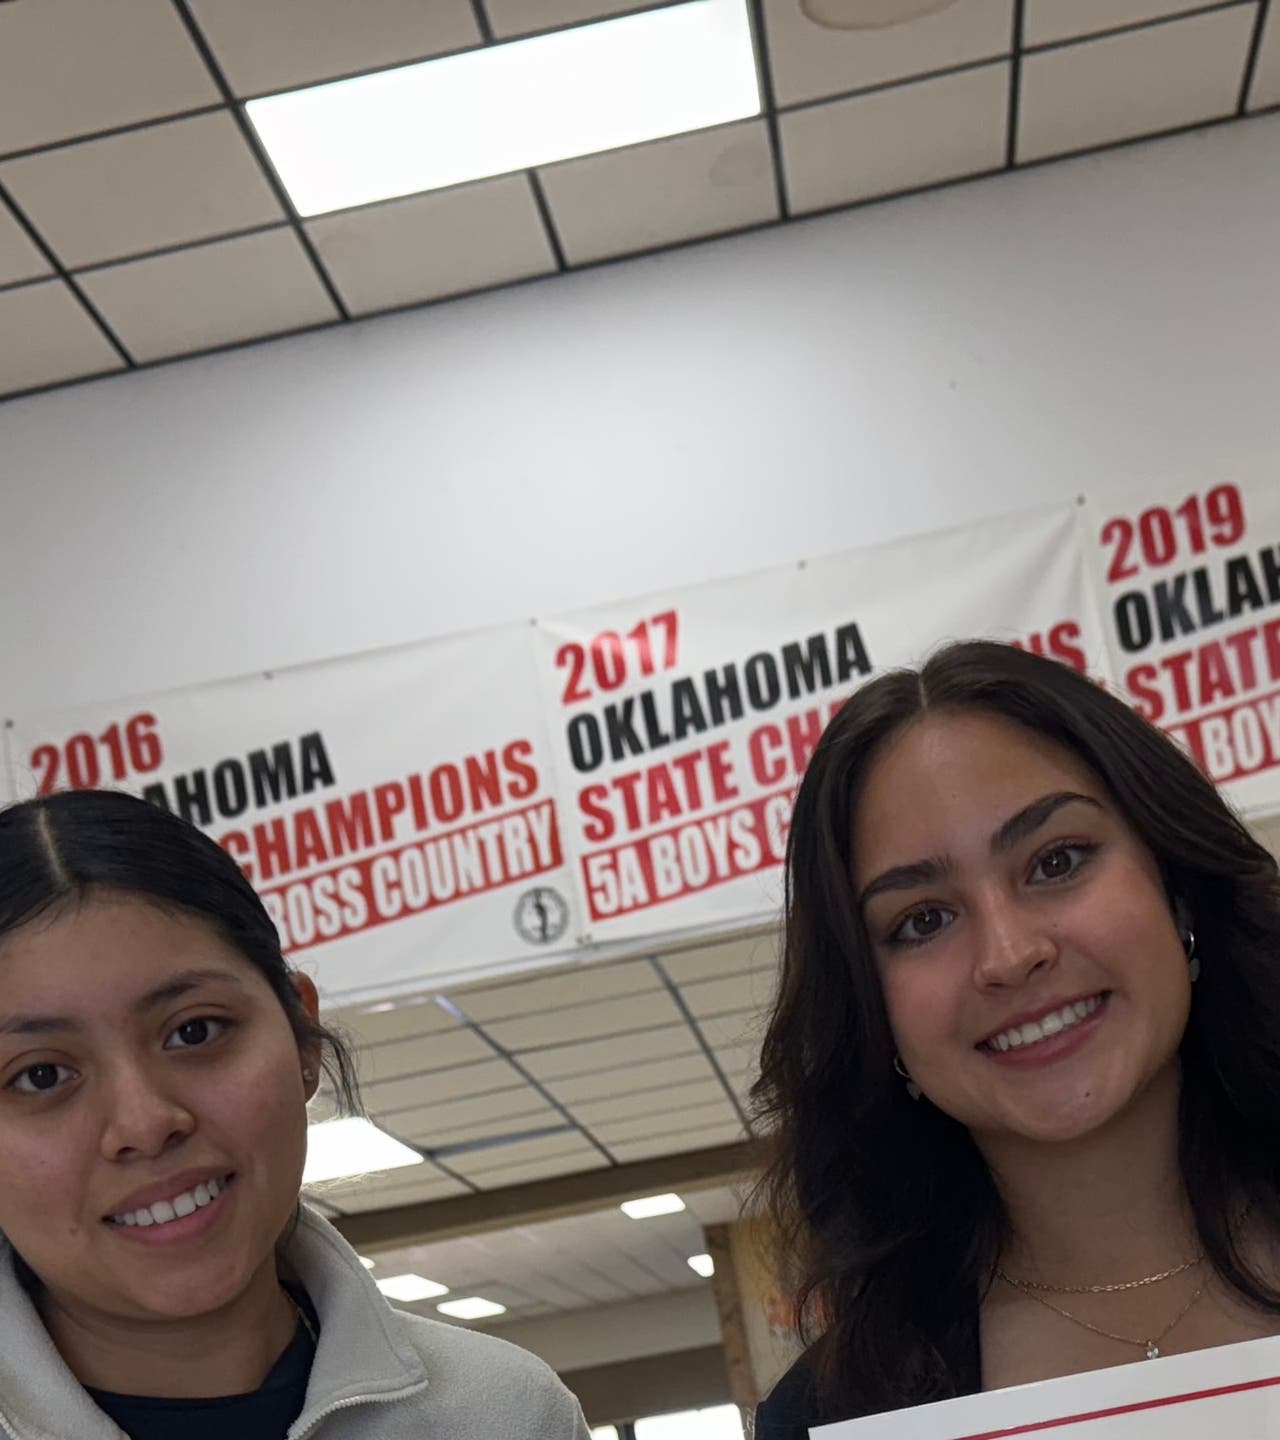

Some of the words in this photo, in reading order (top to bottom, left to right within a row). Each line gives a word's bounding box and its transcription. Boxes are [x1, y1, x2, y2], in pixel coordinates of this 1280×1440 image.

[1100, 483, 1246, 583] 2019
[555, 608, 679, 707] 2017
[566, 621, 872, 774] OKLAHOMA
[30, 712, 162, 797] 2016
[578, 740, 739, 843] STATE
[370, 803, 554, 918] COUNTRY
[587, 844, 651, 916] 5A
[649, 806, 761, 898] BOYS
